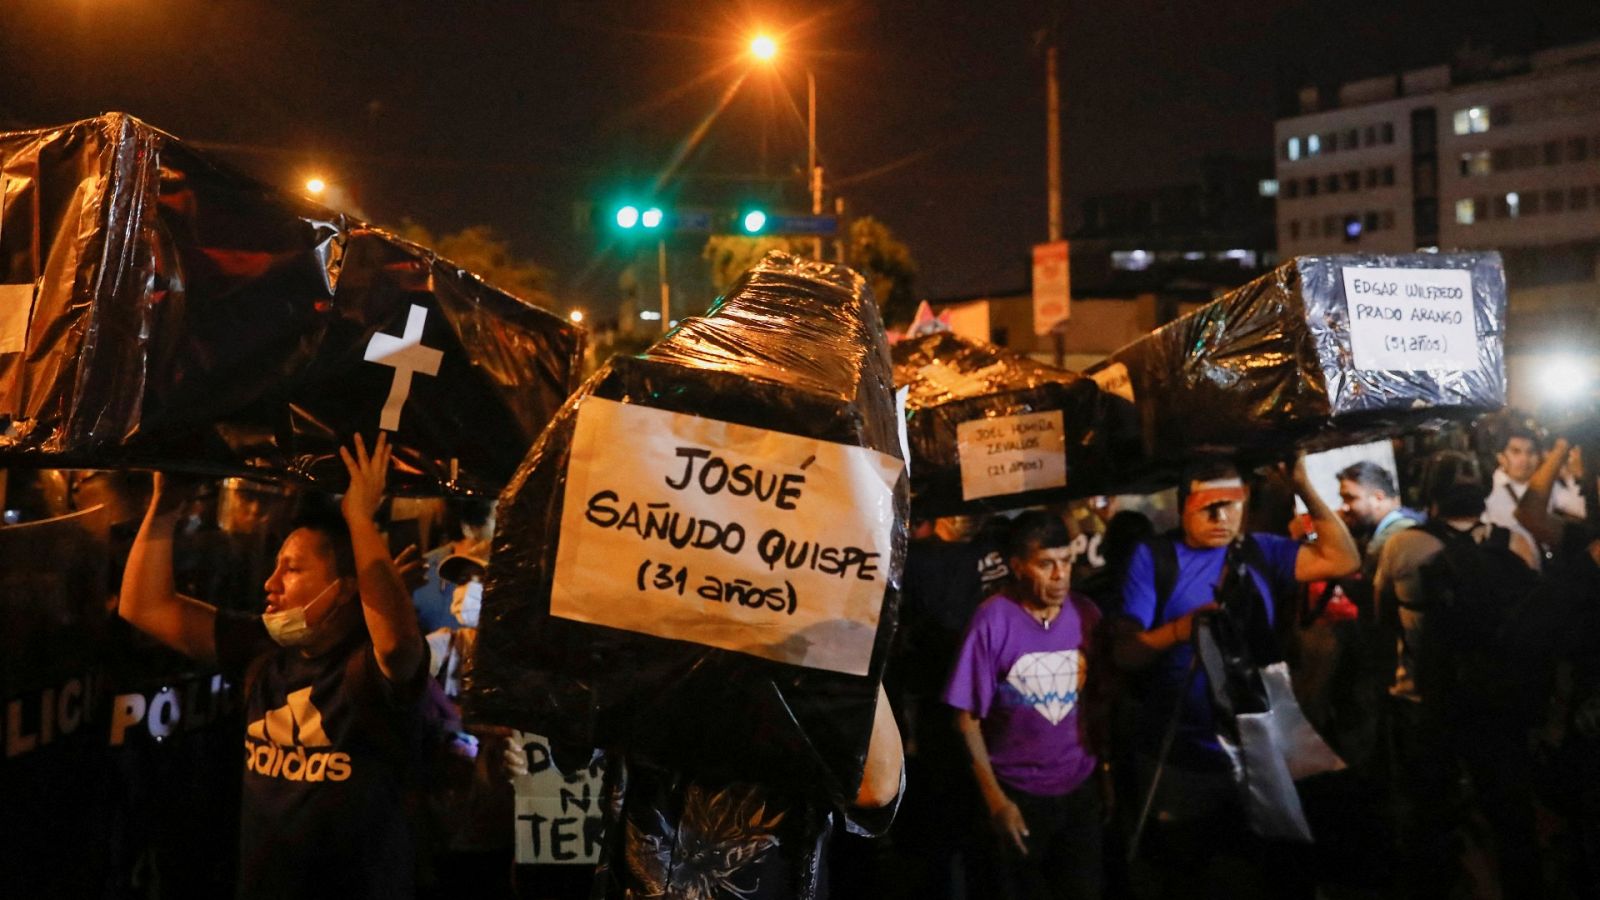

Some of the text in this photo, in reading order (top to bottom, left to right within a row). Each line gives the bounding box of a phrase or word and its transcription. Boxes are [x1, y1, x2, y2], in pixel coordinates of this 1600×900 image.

[1354, 279, 1463, 301] EDGAR WILFREDO
[1356, 303, 1463, 324] PRADO ARANGO
[1384, 334, 1448, 354] (51 años)
[975, 426, 1005, 442] JOEL
[665, 447, 816, 510] JOSUÉ
[585, 489, 880, 581] SAÑUDO QUISPE
[637, 559, 797, 615] (31 años)
[560, 782, 604, 815] N
